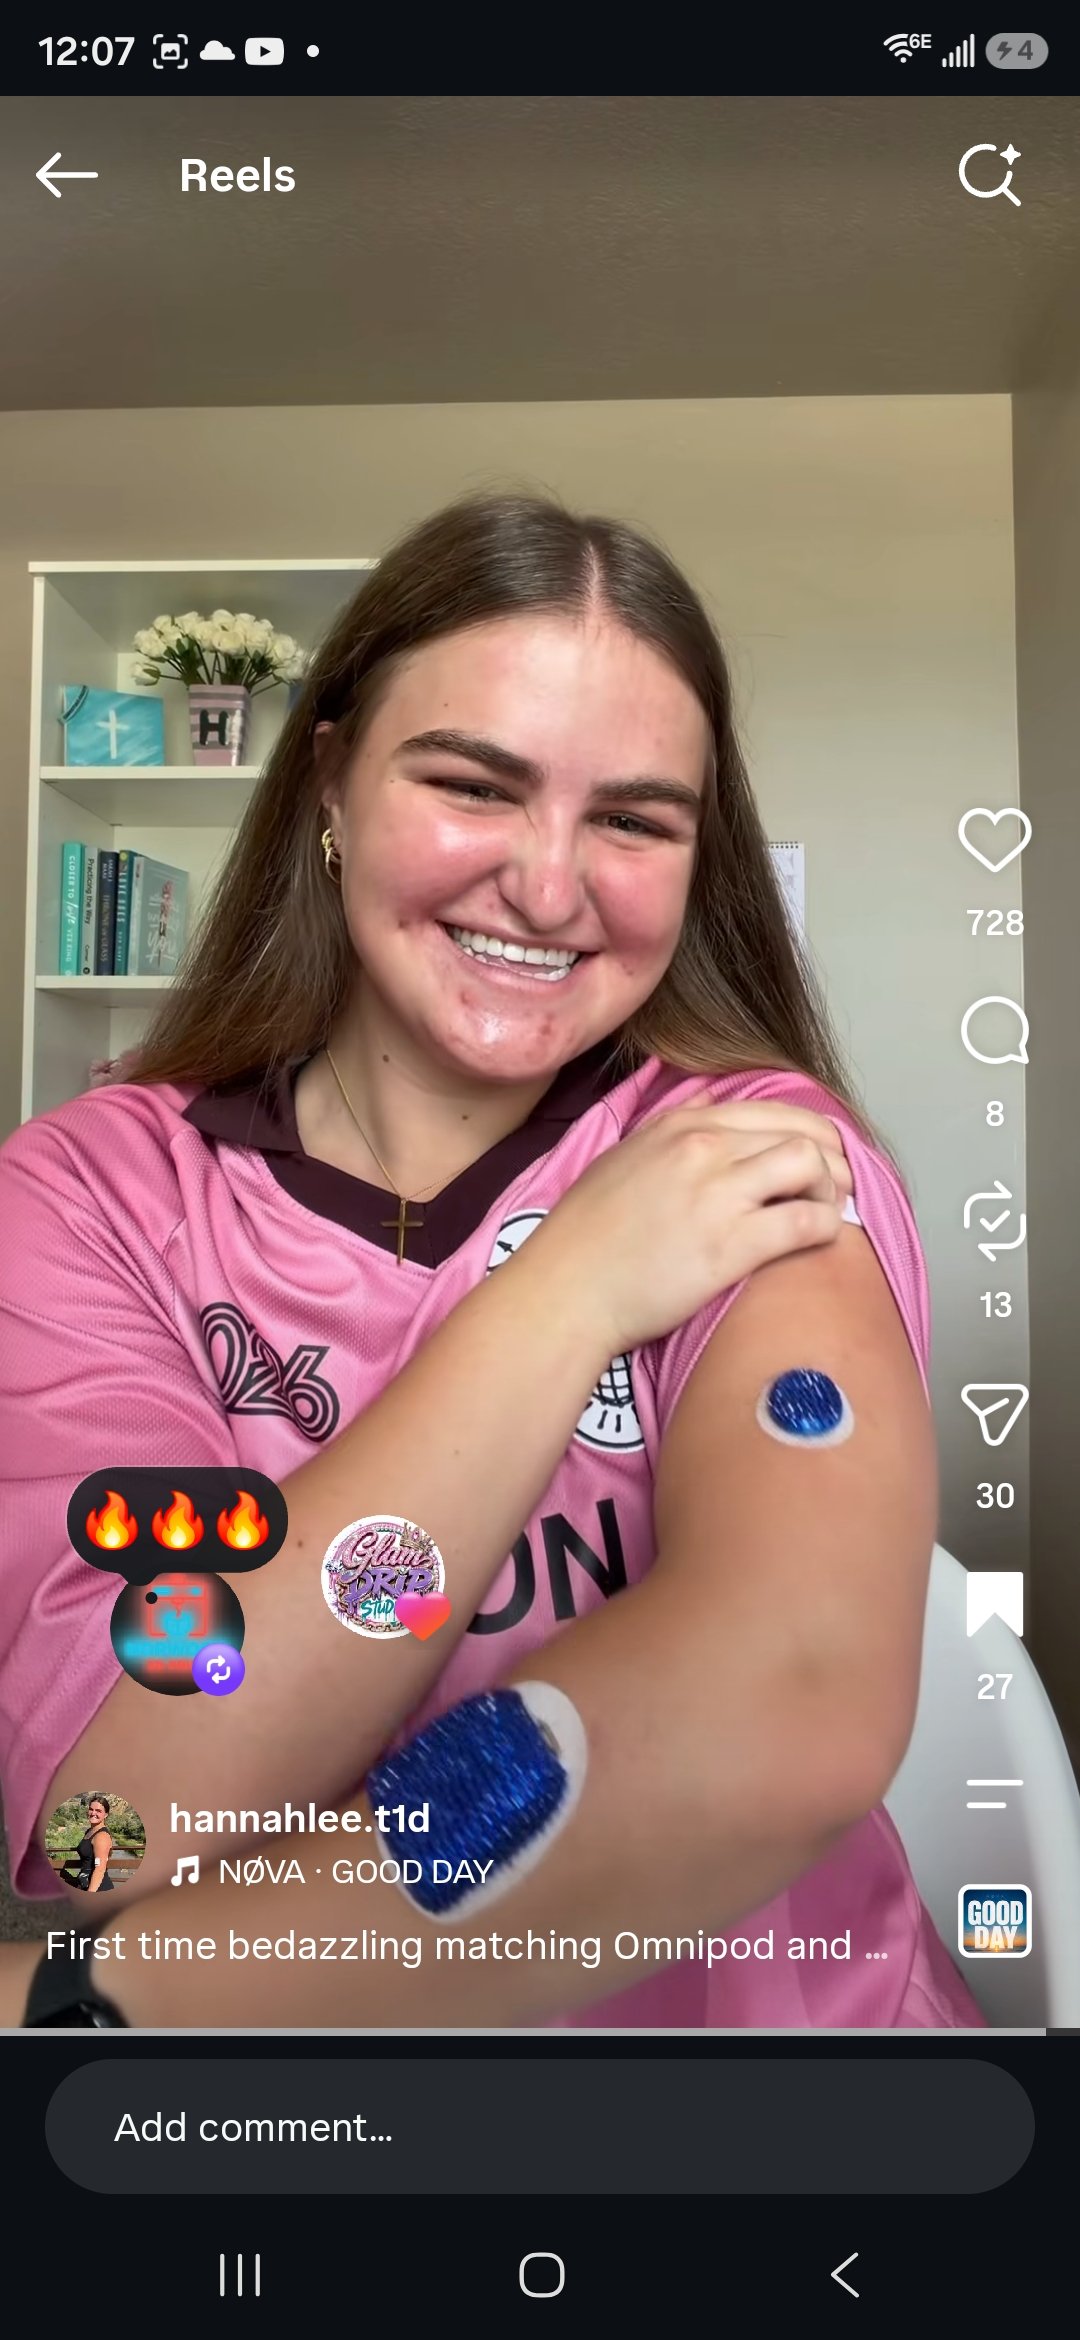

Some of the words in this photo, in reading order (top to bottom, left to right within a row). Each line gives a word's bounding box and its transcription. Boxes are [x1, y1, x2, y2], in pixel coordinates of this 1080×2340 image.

[199, 709, 229, 746] H
[85, 858, 95, 895] Practicing
[85, 895, 94, 908] the
[84, 909, 93, 925] Way
